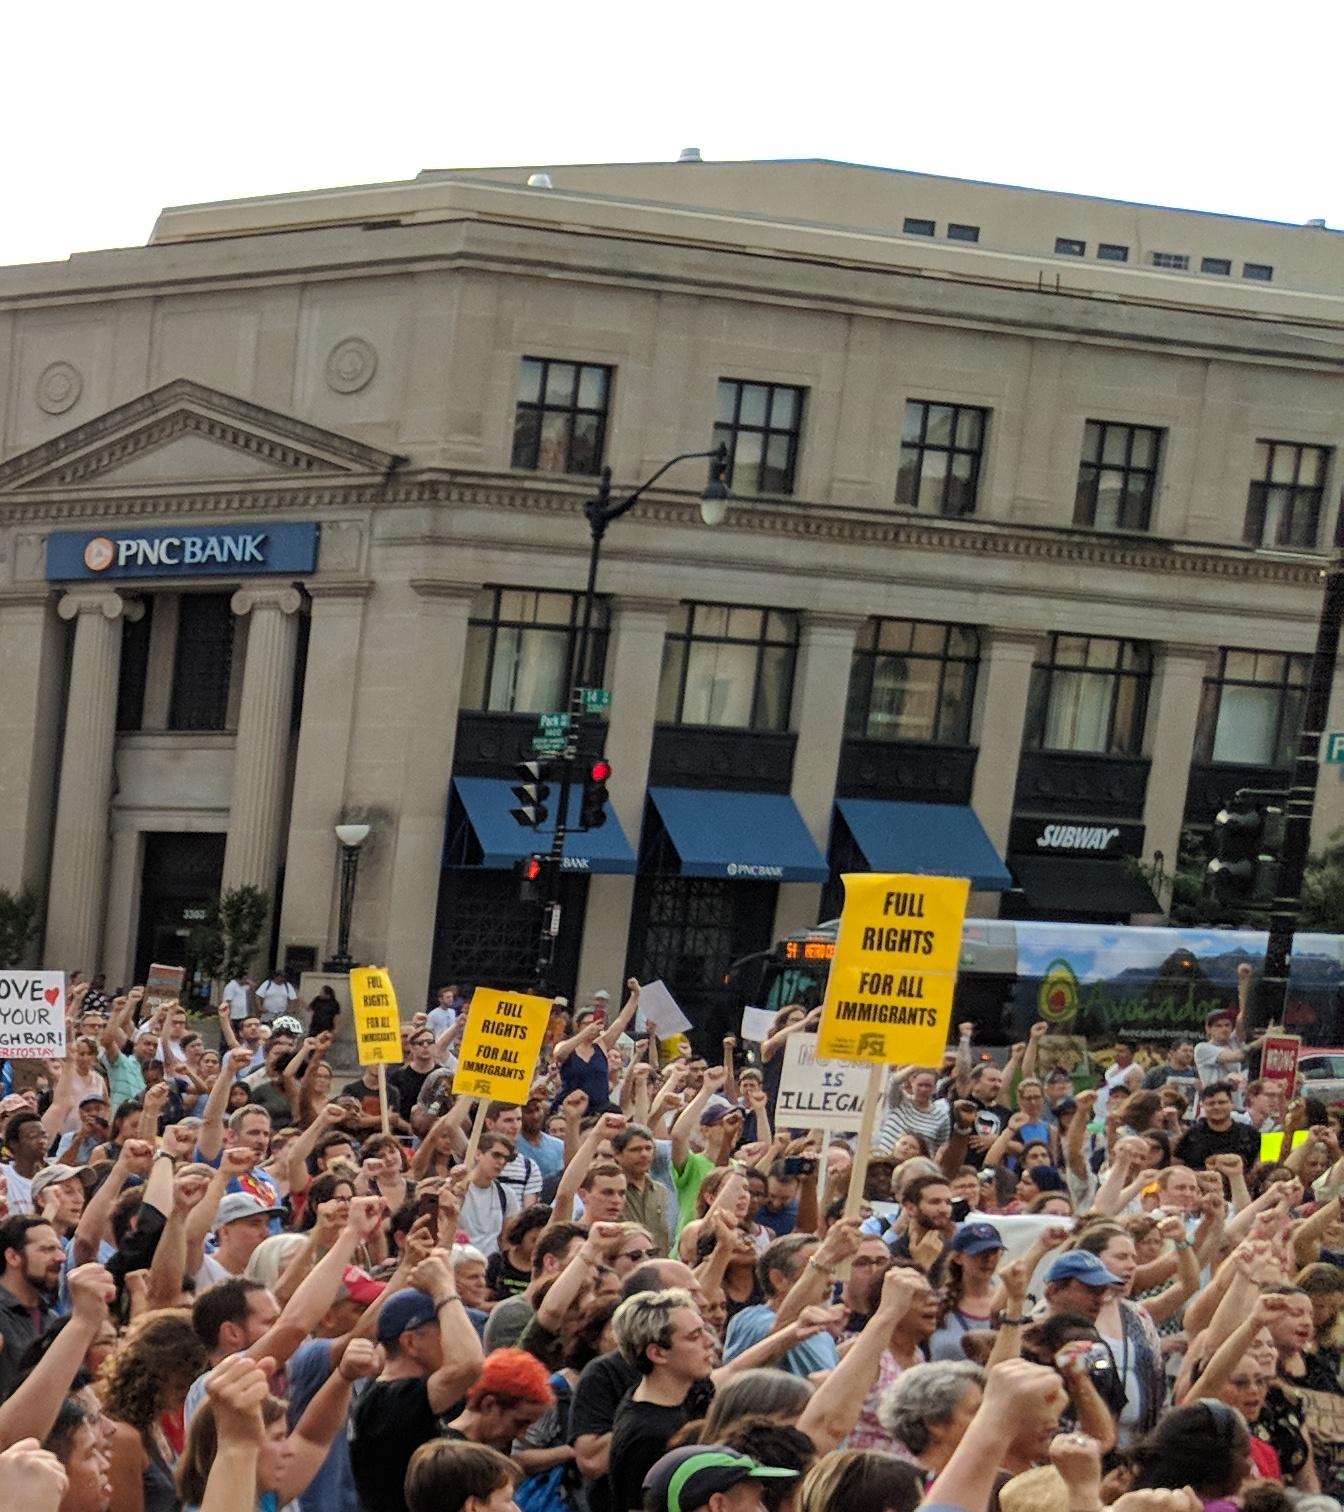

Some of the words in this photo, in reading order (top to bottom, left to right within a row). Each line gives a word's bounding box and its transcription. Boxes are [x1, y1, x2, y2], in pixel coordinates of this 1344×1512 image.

[182, 534, 266, 564] BANK
[1036, 824, 1114, 850] SUBWAY
[562, 858, 590, 869] BANK
[883, 891, 925, 918] FULL
[862, 926, 935, 956] RIGHTS
[367, 976, 383, 989] FULL
[858, 972, 894, 996] FOR
[897, 975, 924, 999] ALL
[363, 994, 389, 1008] RIGHTS
[496, 1000, 524, 1019] FULL
[366, 1017, 381, 1029] FOR
[381, 1017, 390, 1028] ALL
[835, 1001, 938, 1028] IMMIGRANTS
[362, 1032, 397, 1043] IMMIGRANTS
[481, 1019, 528, 1040] RIGHTS
[476, 1044, 499, 1061] FOR
[500, 1047, 519, 1064] ALL
[462, 1060, 526, 1081] IMMIGRANTS
[821, 1072, 845, 1087] IS
